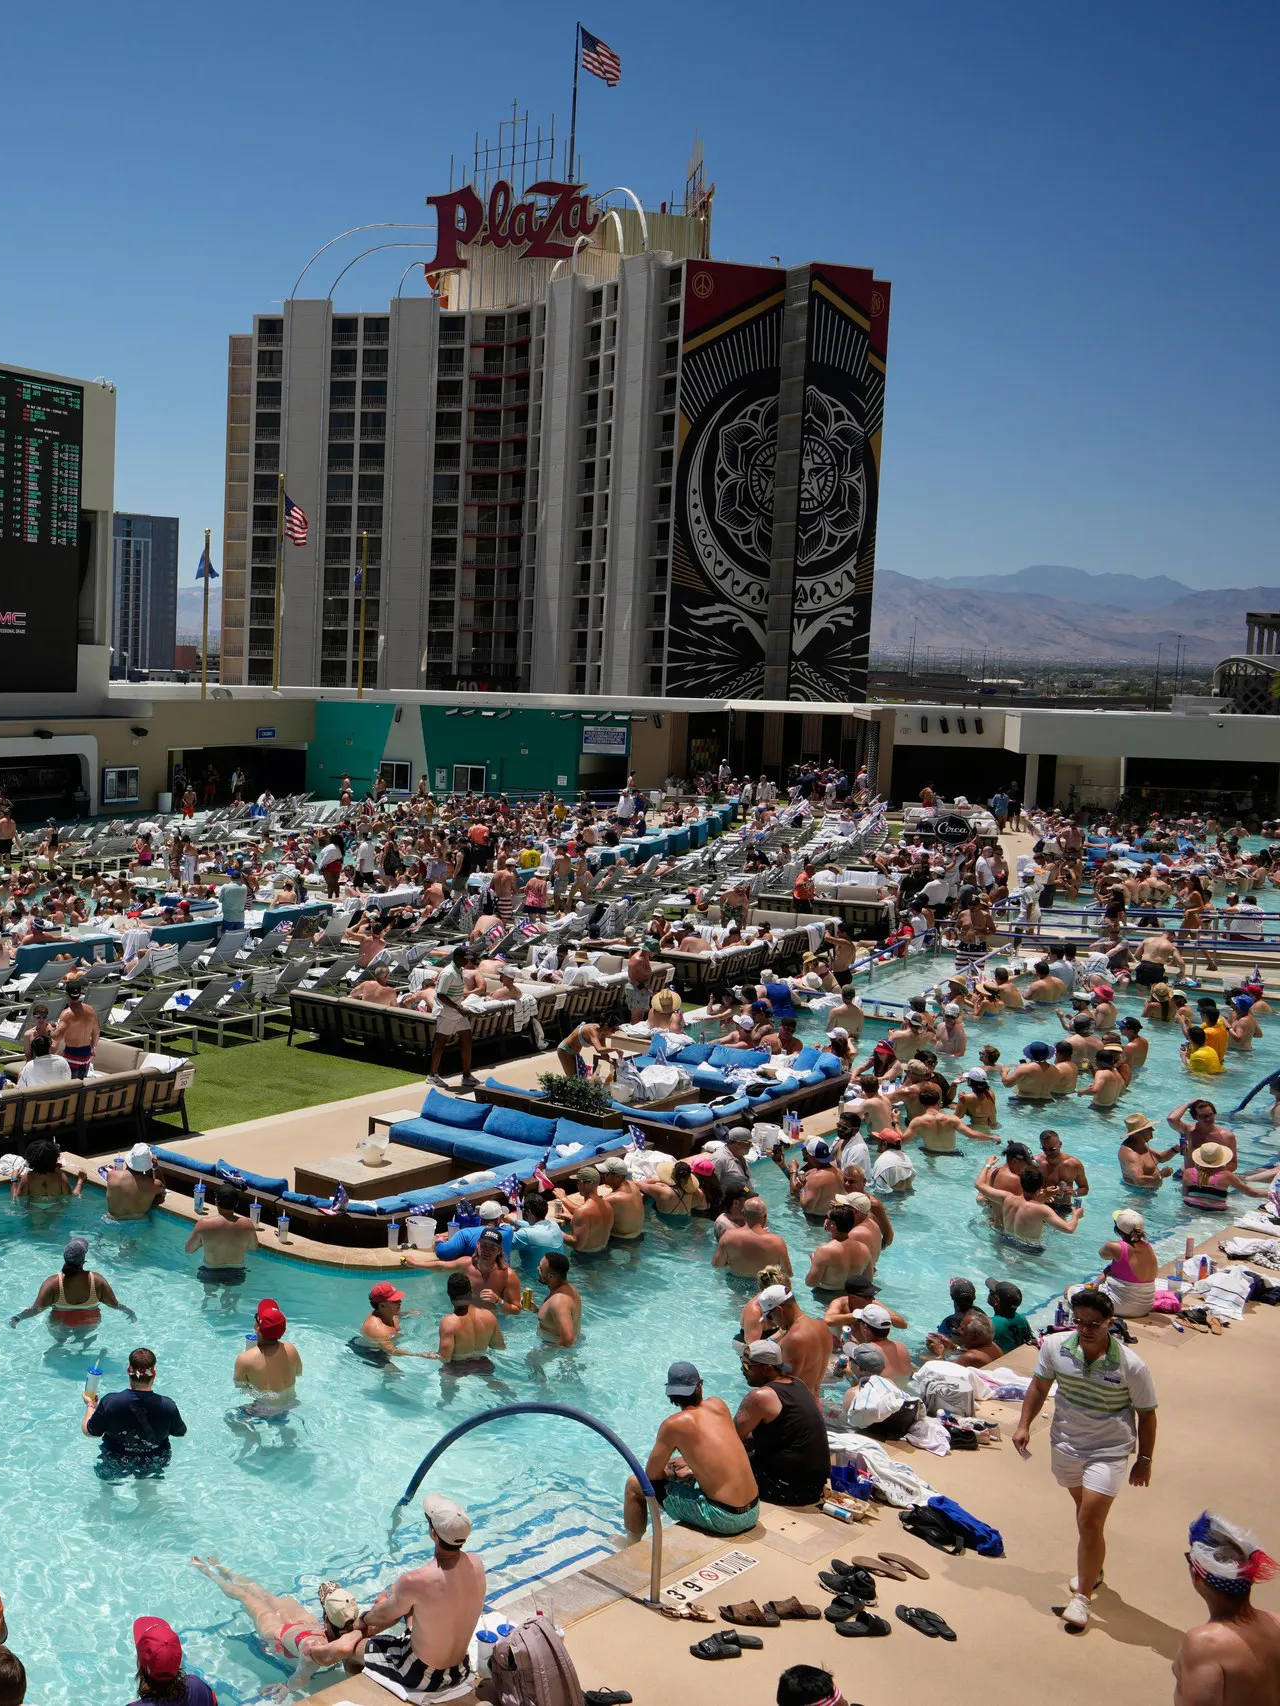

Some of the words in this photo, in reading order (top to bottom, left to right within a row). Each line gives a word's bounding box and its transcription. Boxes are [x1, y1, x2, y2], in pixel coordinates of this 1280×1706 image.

[937, 821, 969, 835] Circa
[666, 1589, 687, 1601] 3
[682, 1580, 704, 1592] 9
